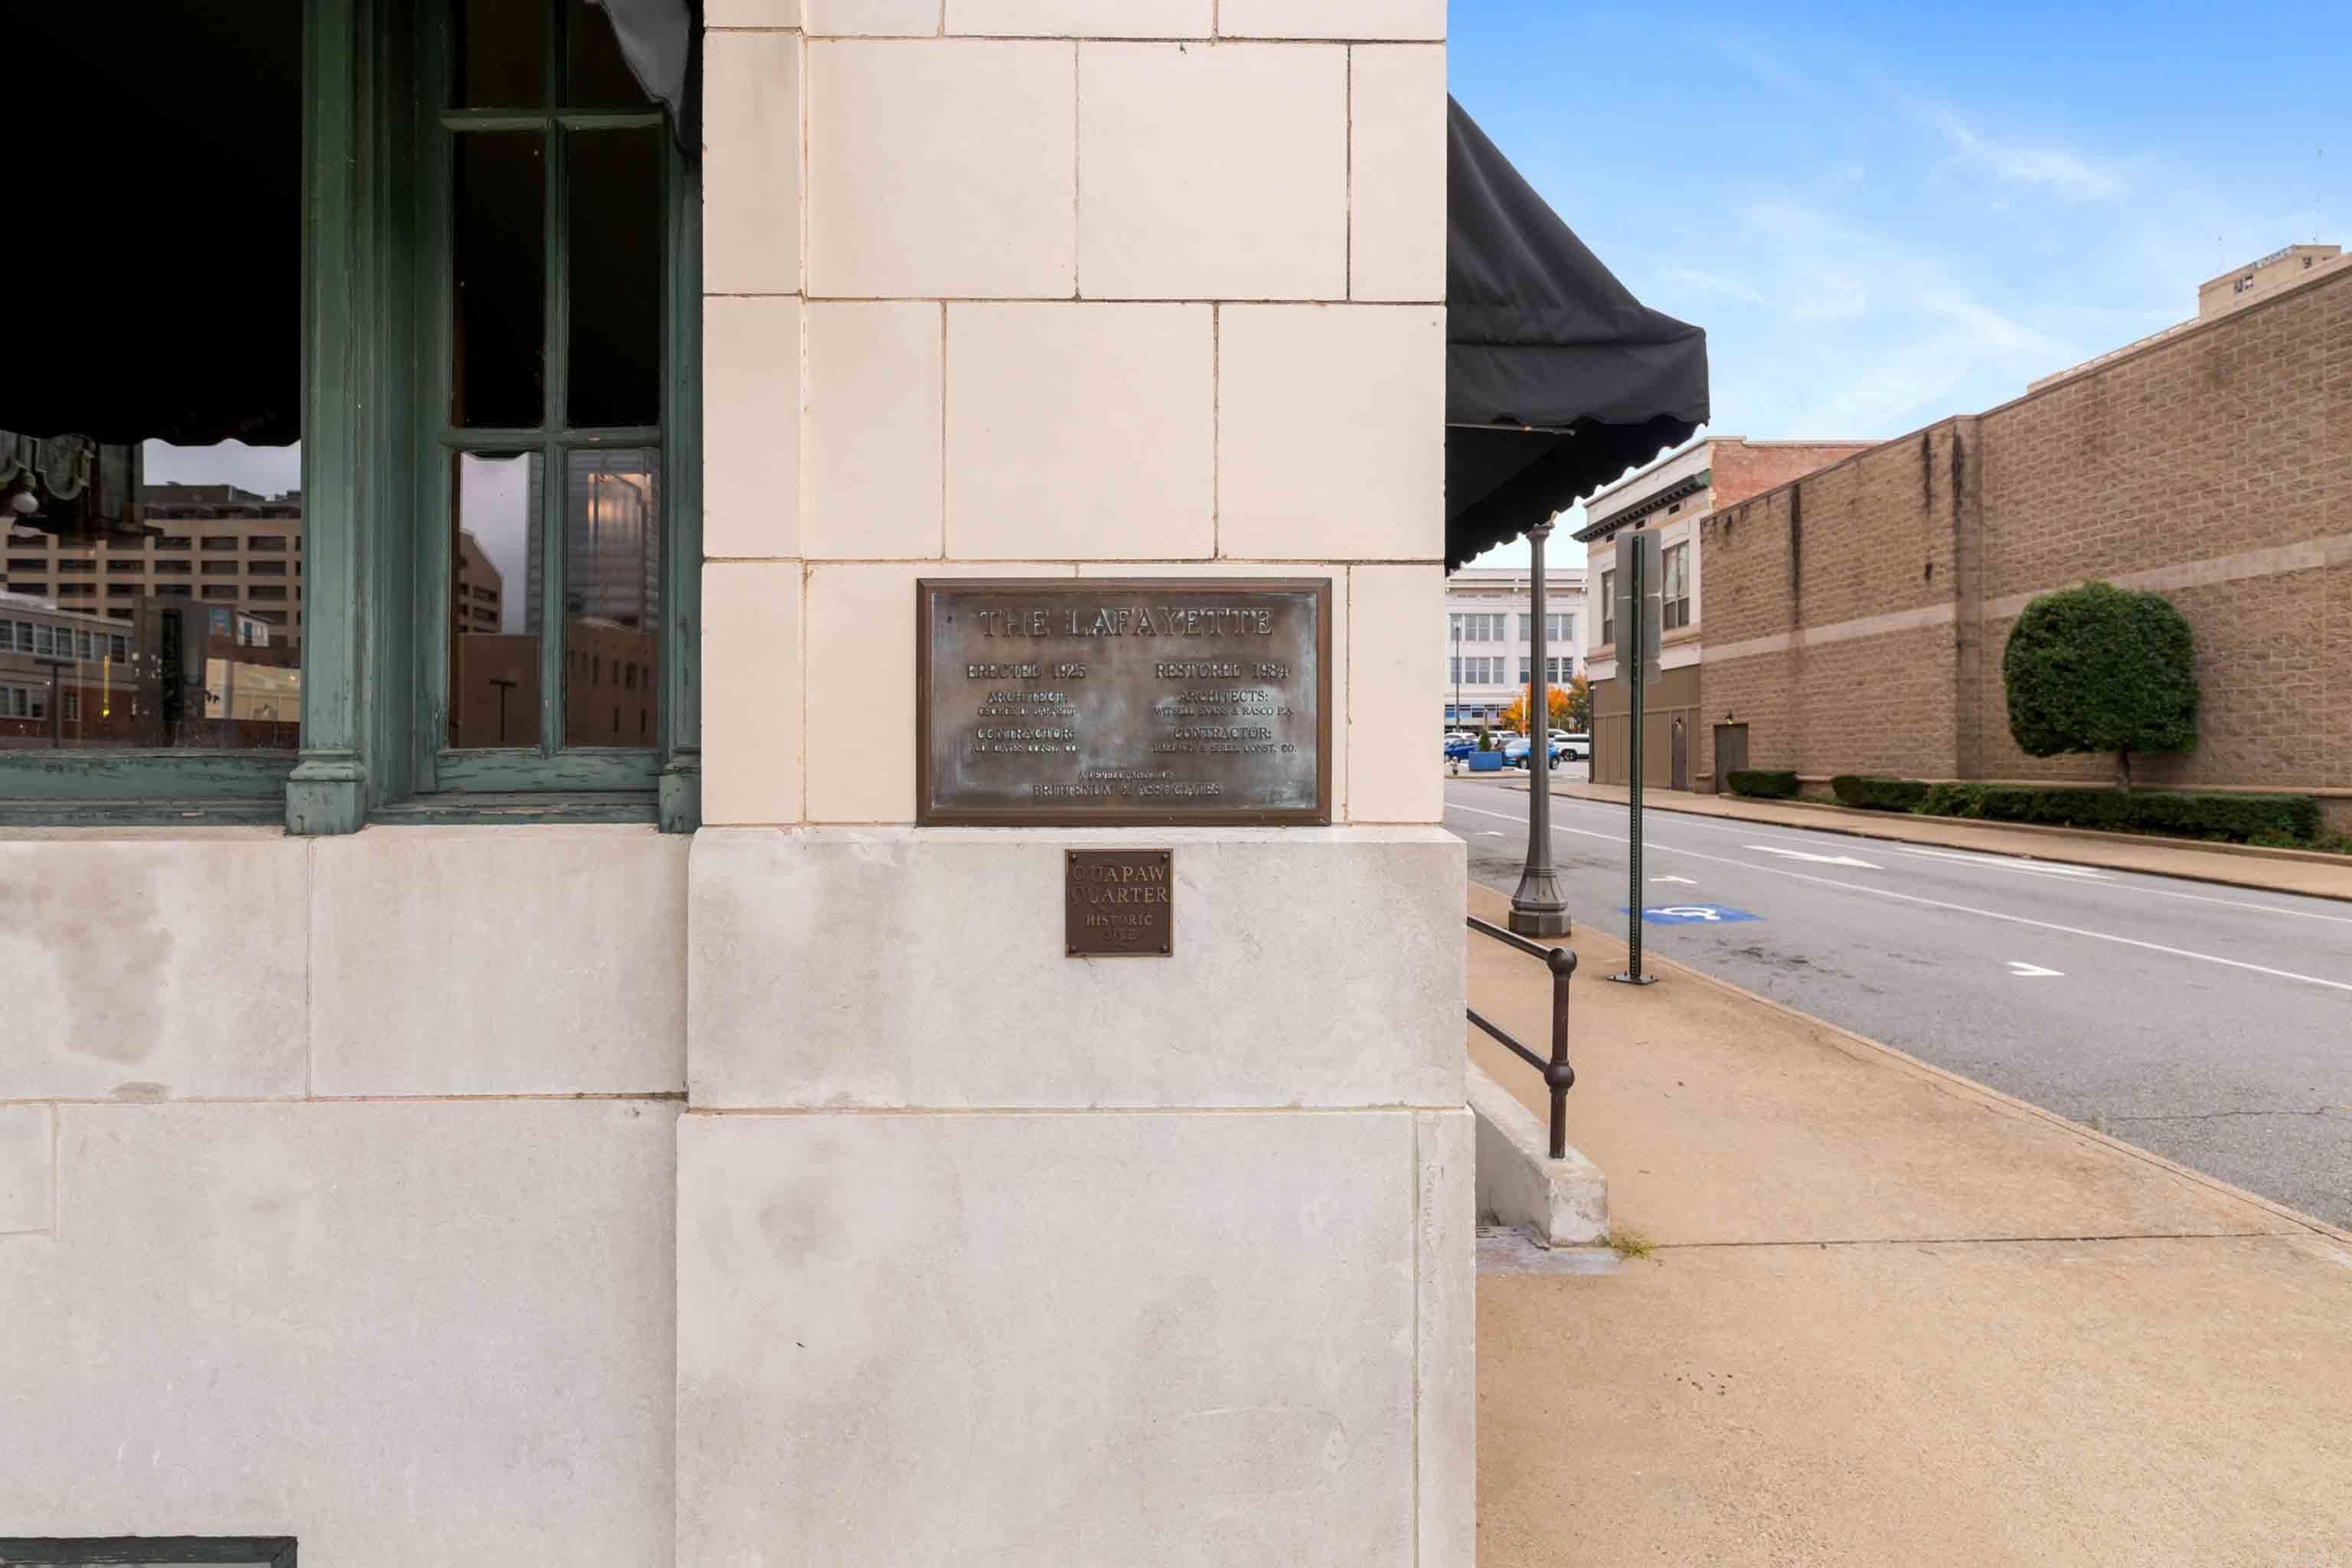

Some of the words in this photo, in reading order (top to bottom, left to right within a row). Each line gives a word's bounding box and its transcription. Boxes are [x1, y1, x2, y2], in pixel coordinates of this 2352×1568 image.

[980, 608, 1050, 637] THE
[1065, 607, 1274, 637] LAFAYETTE
[967, 662, 1041, 678] ERECTED
[1052, 662, 1086, 678] 1925
[1155, 662, 1243, 678] RESTORED
[1252, 662, 1291, 678] 1984
[1179, 691, 1269, 703] ARCHITECTS:
[1243, 707, 1273, 717] RASCO
[1173, 727, 1272, 740] CONTRACTOR:
[1084, 914, 1152, 926] HISTRIC
